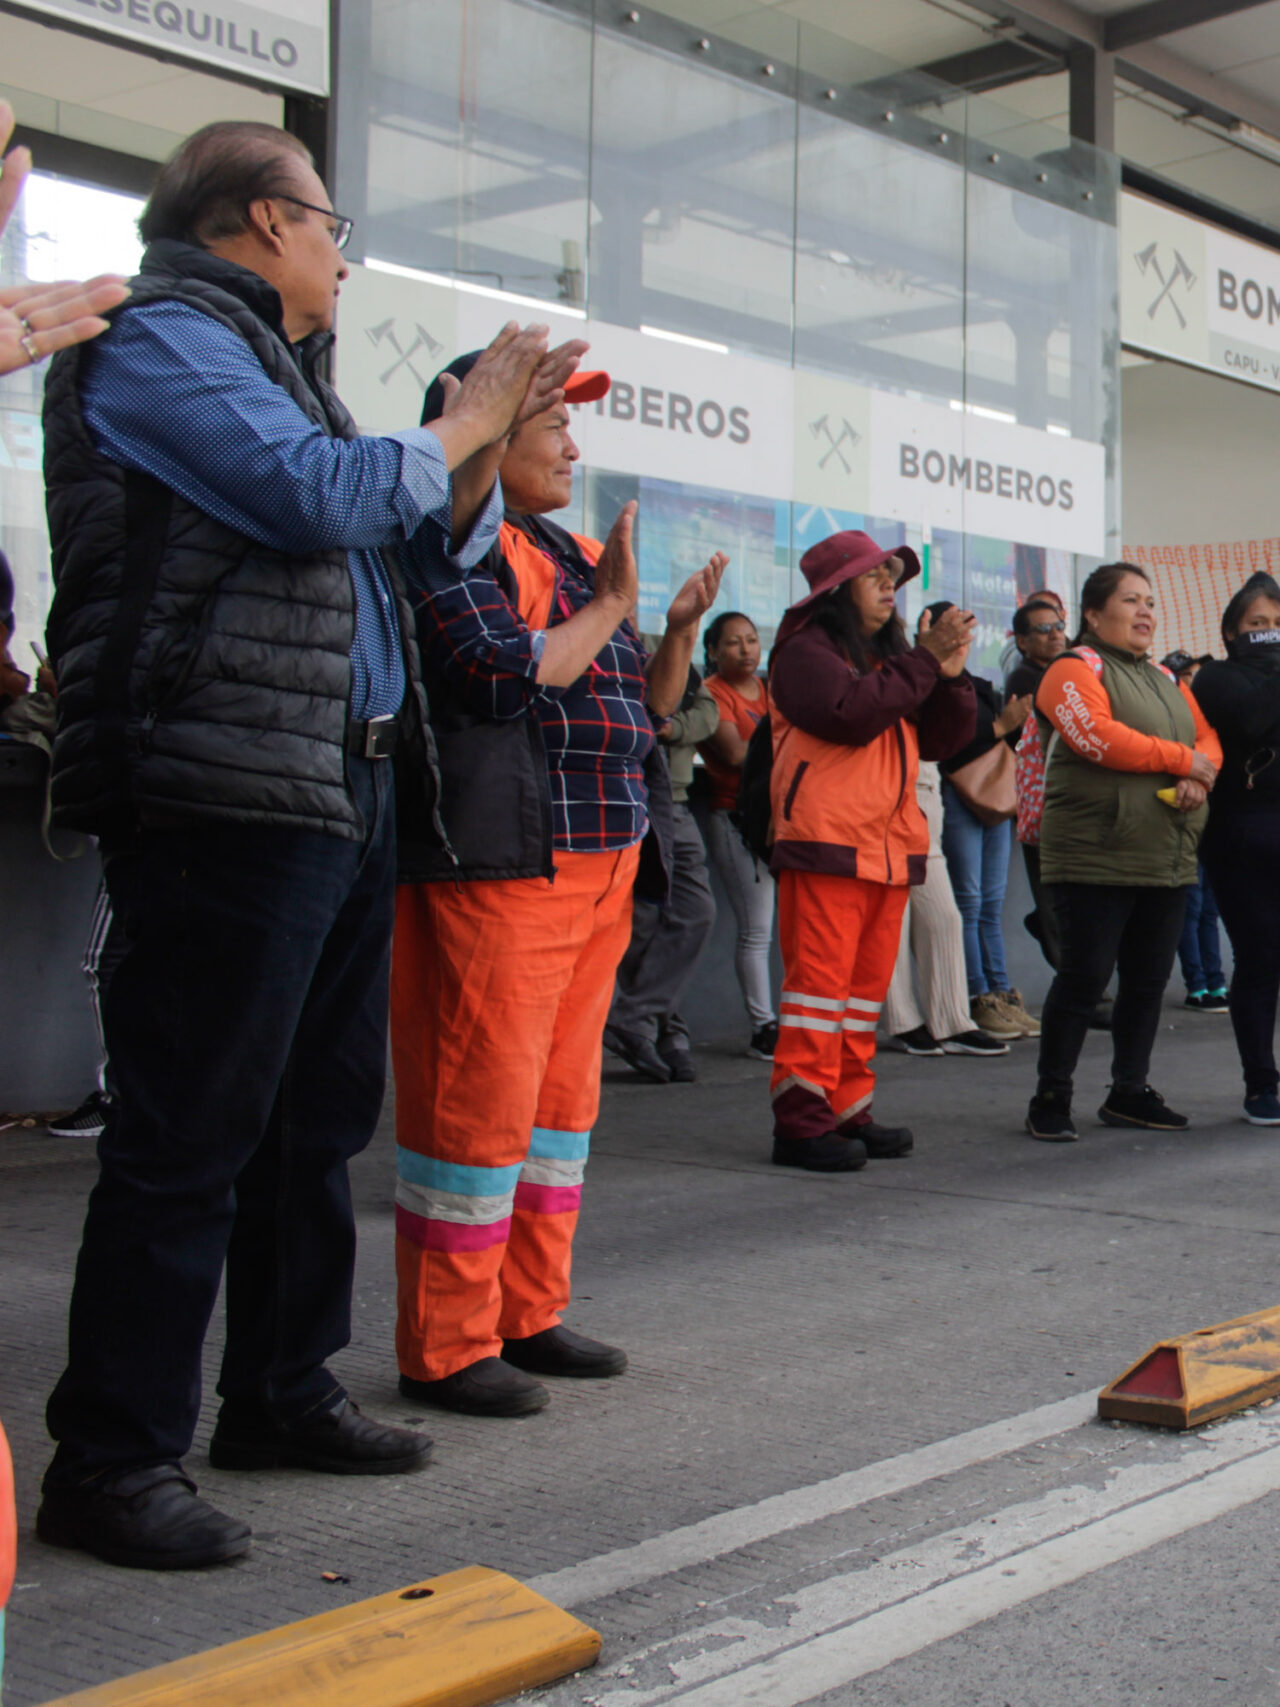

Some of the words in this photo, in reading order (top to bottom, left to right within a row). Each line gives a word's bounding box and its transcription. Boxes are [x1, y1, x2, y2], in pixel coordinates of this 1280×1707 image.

[75, 0, 299, 68] SEQUILLO
[1224, 349, 1260, 375] CAPU
[573, 379, 751, 444] BEROS
[899, 442, 1074, 511] BOMBEROS
[1055, 703, 1104, 762] Contigo
[1062, 681, 1096, 732] rumbo
